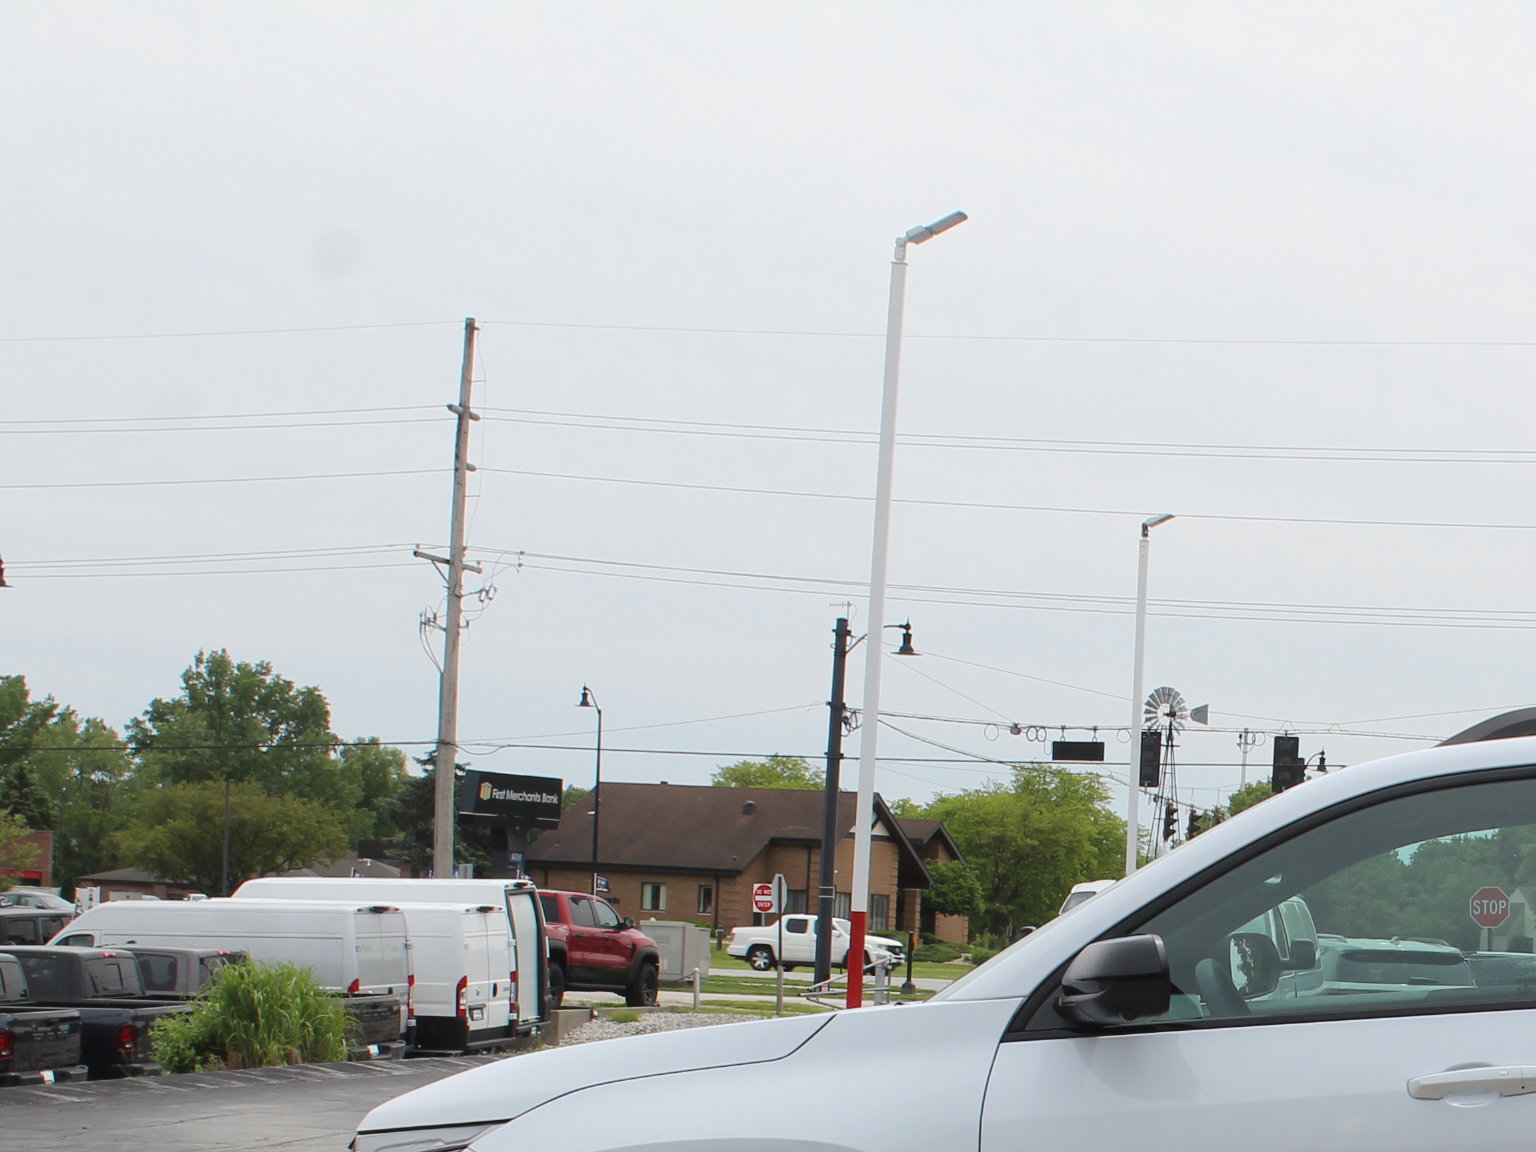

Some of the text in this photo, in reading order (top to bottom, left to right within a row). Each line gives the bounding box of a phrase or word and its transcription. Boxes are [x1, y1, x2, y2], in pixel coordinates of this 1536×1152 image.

[492, 788, 559, 804] First Merchants Bank
[1473, 900, 1507, 915] STOP
